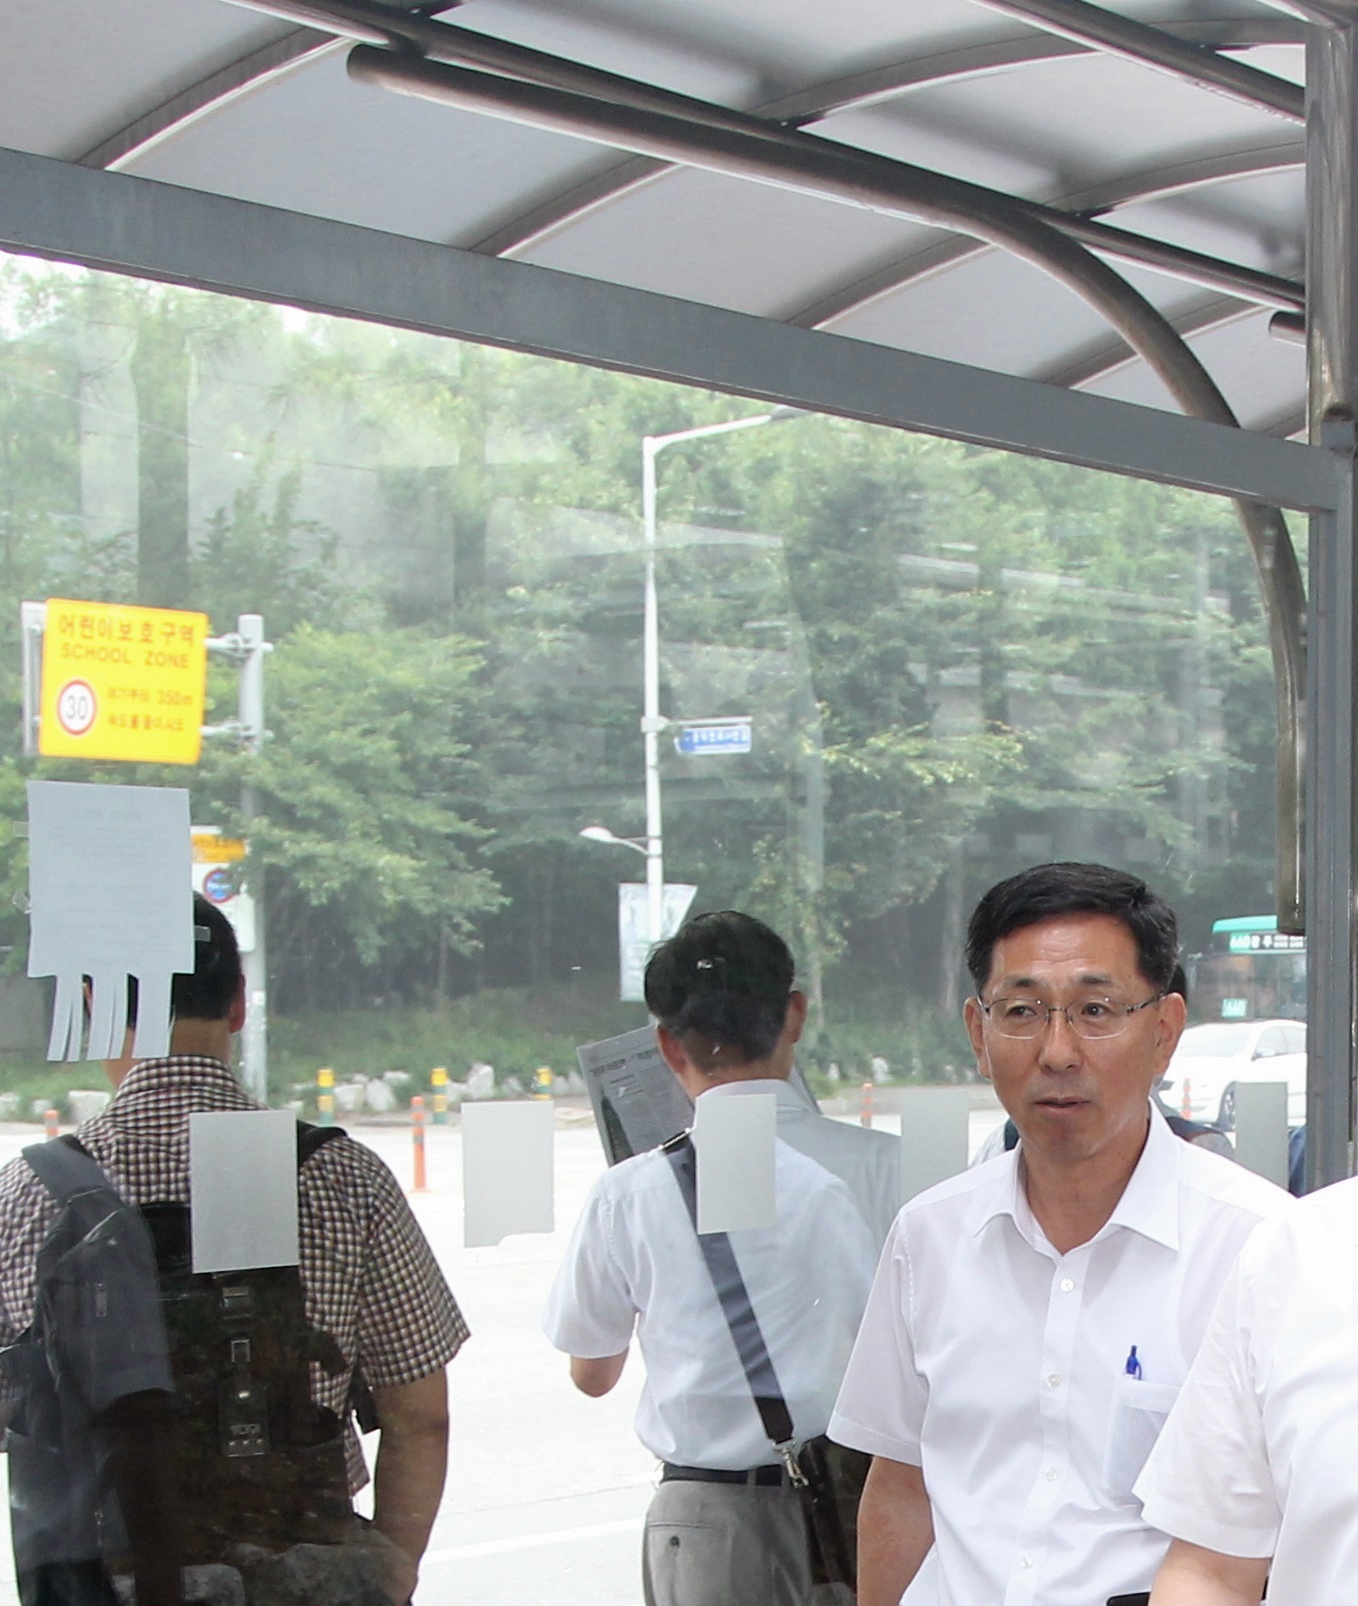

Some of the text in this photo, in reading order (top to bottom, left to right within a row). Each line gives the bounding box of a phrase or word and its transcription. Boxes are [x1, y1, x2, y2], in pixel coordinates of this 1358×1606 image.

[58, 614, 195, 648] 어린이보호구역
[60, 642, 190, 669] SCHOOL ZONE
[65, 694, 88, 721] 30
